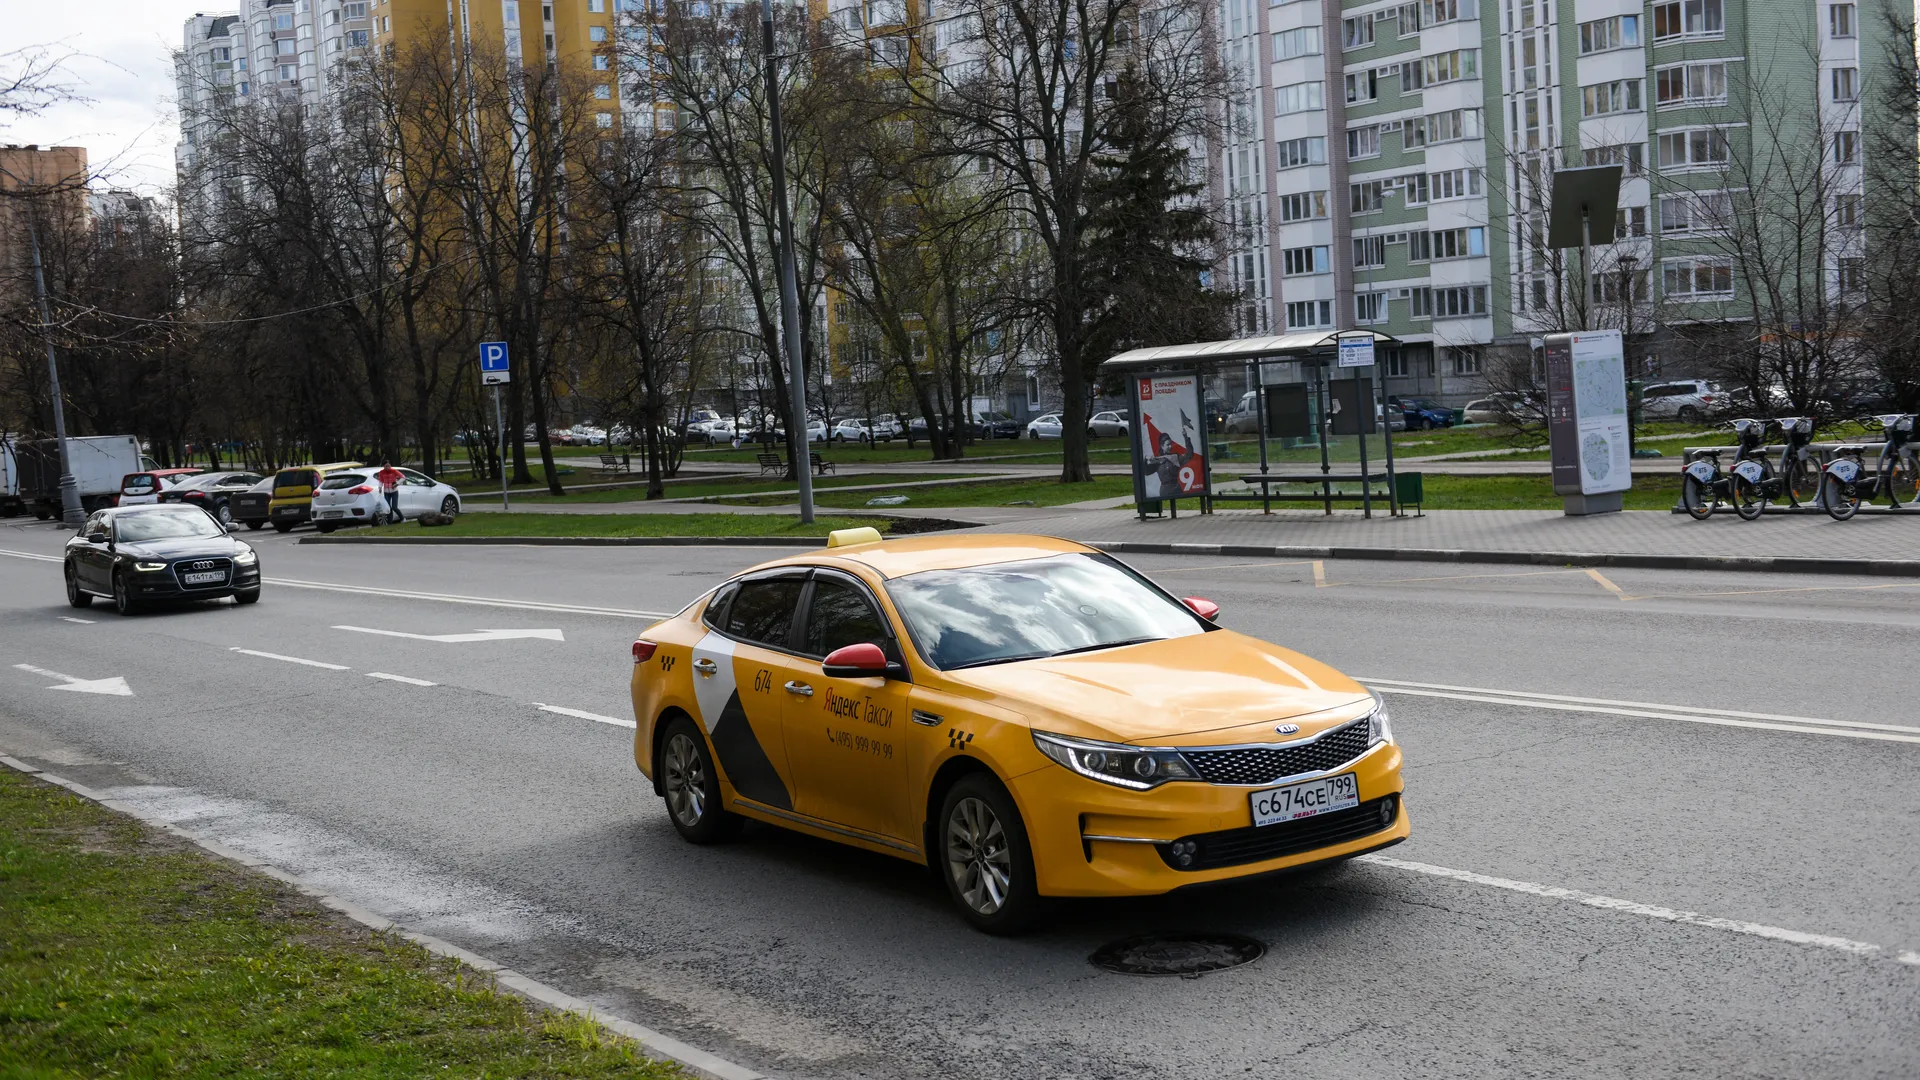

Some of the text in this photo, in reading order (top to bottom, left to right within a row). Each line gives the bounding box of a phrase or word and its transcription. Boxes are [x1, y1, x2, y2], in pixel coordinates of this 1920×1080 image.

[487, 345, 503, 368] P
[1158, 380, 1192, 388] ПРАЗДНИКОМ
[1178, 466, 1195, 492] 9
[754, 668, 773, 695] 674
[823, 686, 893, 728] Яндекс Такси
[835, 730, 893, 760] (495) 999 99 99
[1258, 788, 1327, 816] С674СЕ
[1327, 776, 1352, 796] 799
[1334, 793, 1348, 802] RUS
